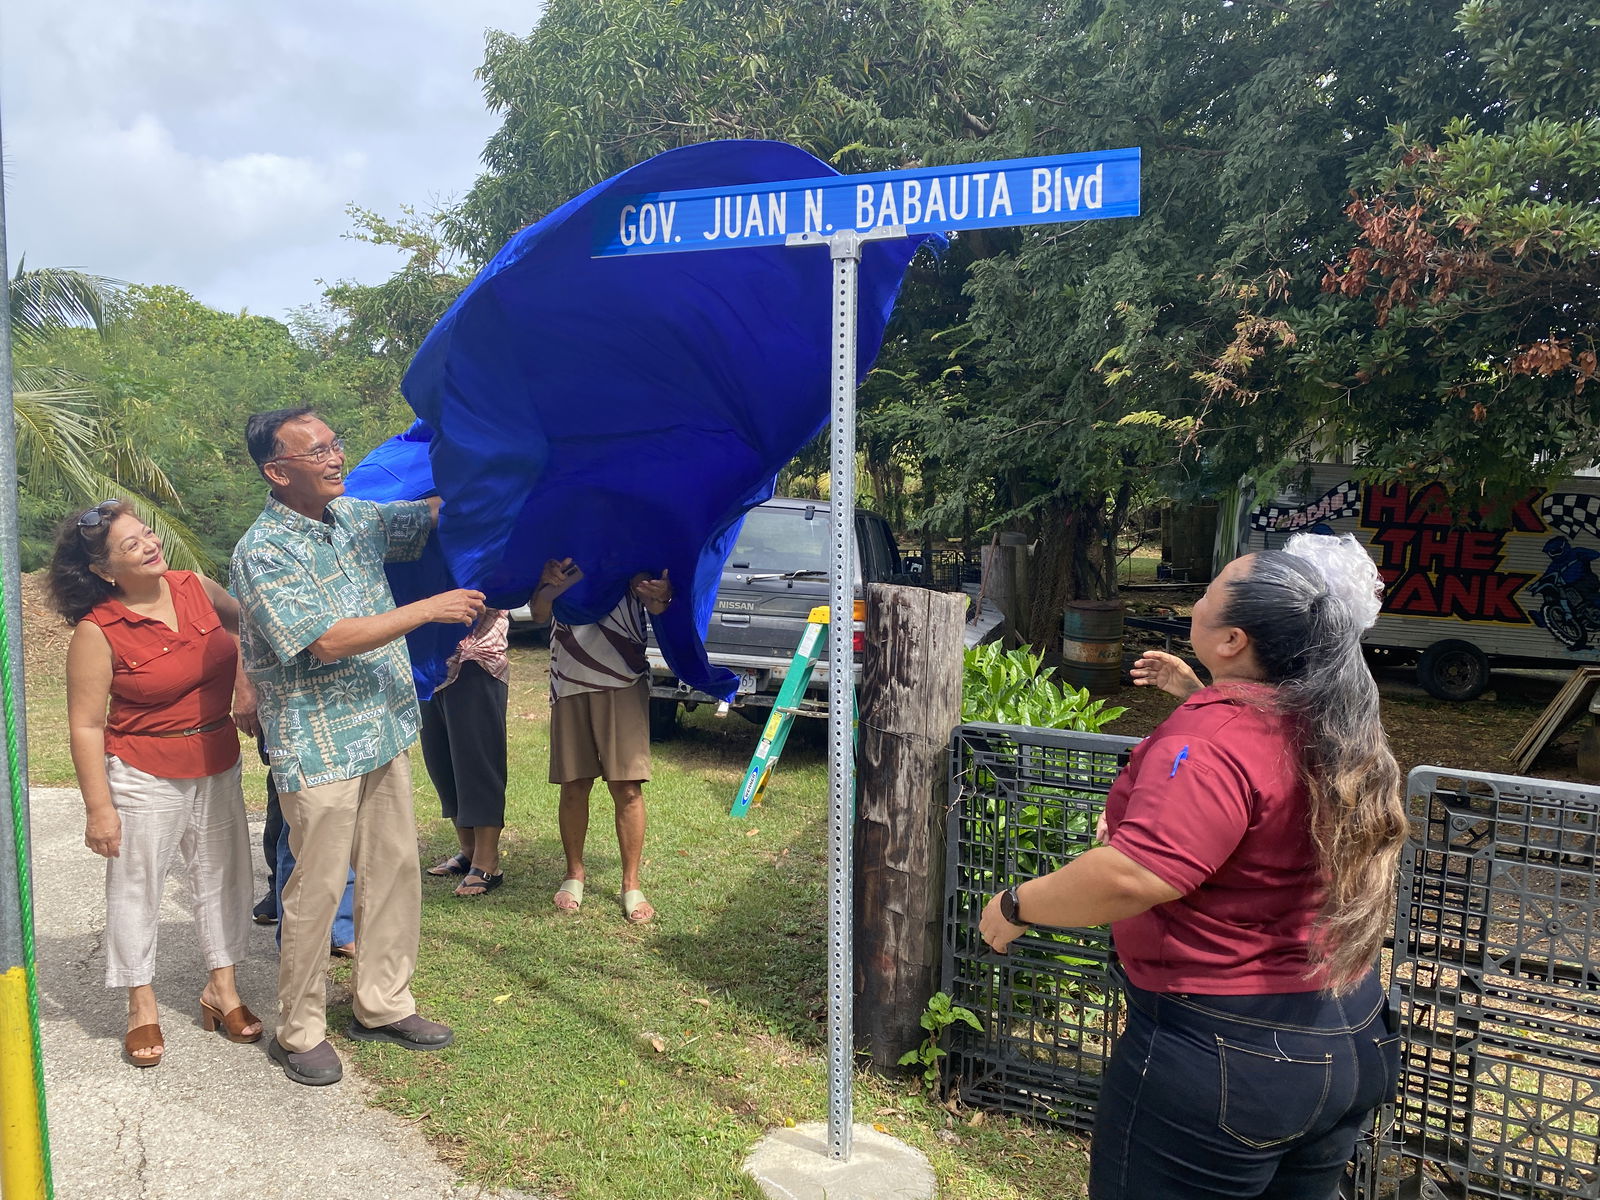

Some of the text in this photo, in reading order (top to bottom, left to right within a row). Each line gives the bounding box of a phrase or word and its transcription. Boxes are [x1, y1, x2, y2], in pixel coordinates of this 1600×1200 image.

[619, 163, 1103, 246] GOV. JUAN N. BABAUTA Blvd
[1369, 484, 1545, 532] HAK
[1379, 528, 1498, 570] THE
[718, 600, 755, 611] NISSAN
